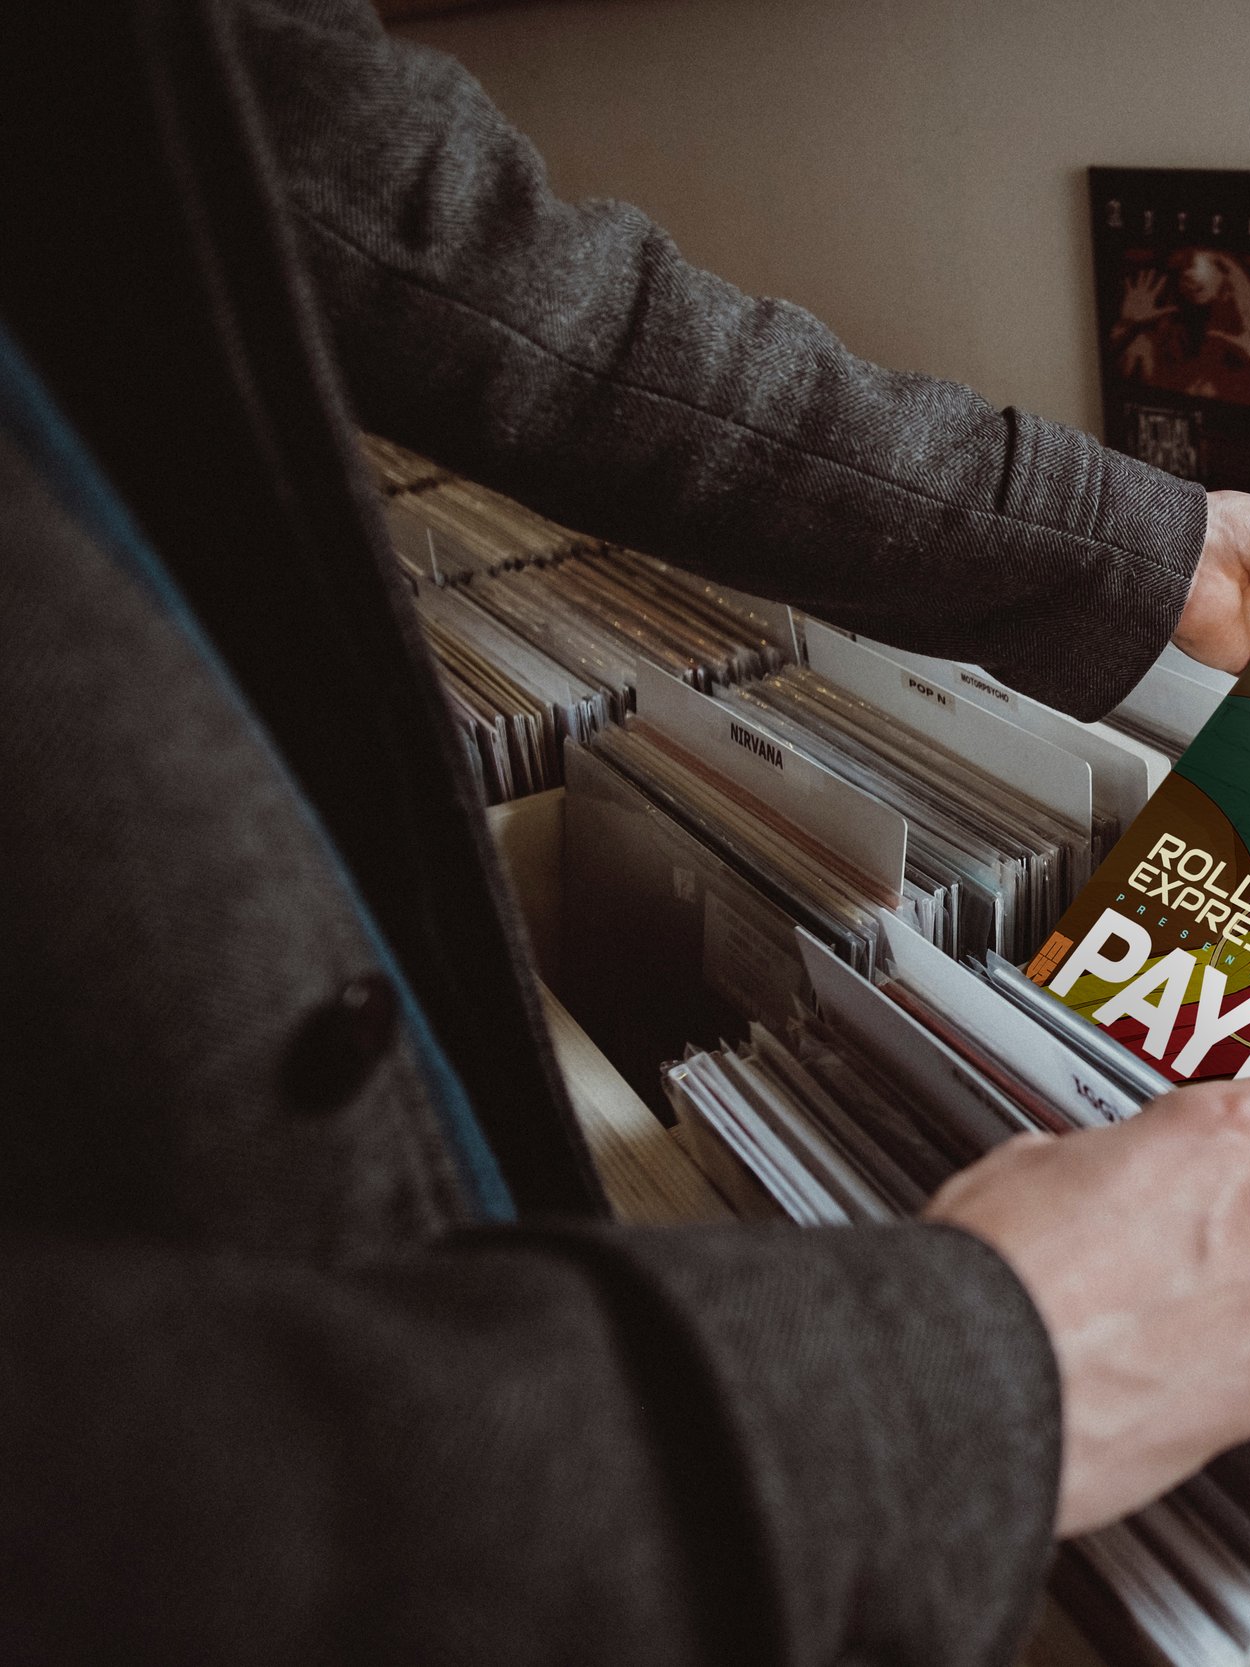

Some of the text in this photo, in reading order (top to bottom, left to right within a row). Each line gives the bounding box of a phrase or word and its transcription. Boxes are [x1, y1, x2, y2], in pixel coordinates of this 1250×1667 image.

[908, 678, 947, 705] POP N
[960, 672, 1010, 703] MOTORPSYCHO
[730, 722, 784, 770] NIRVANA
